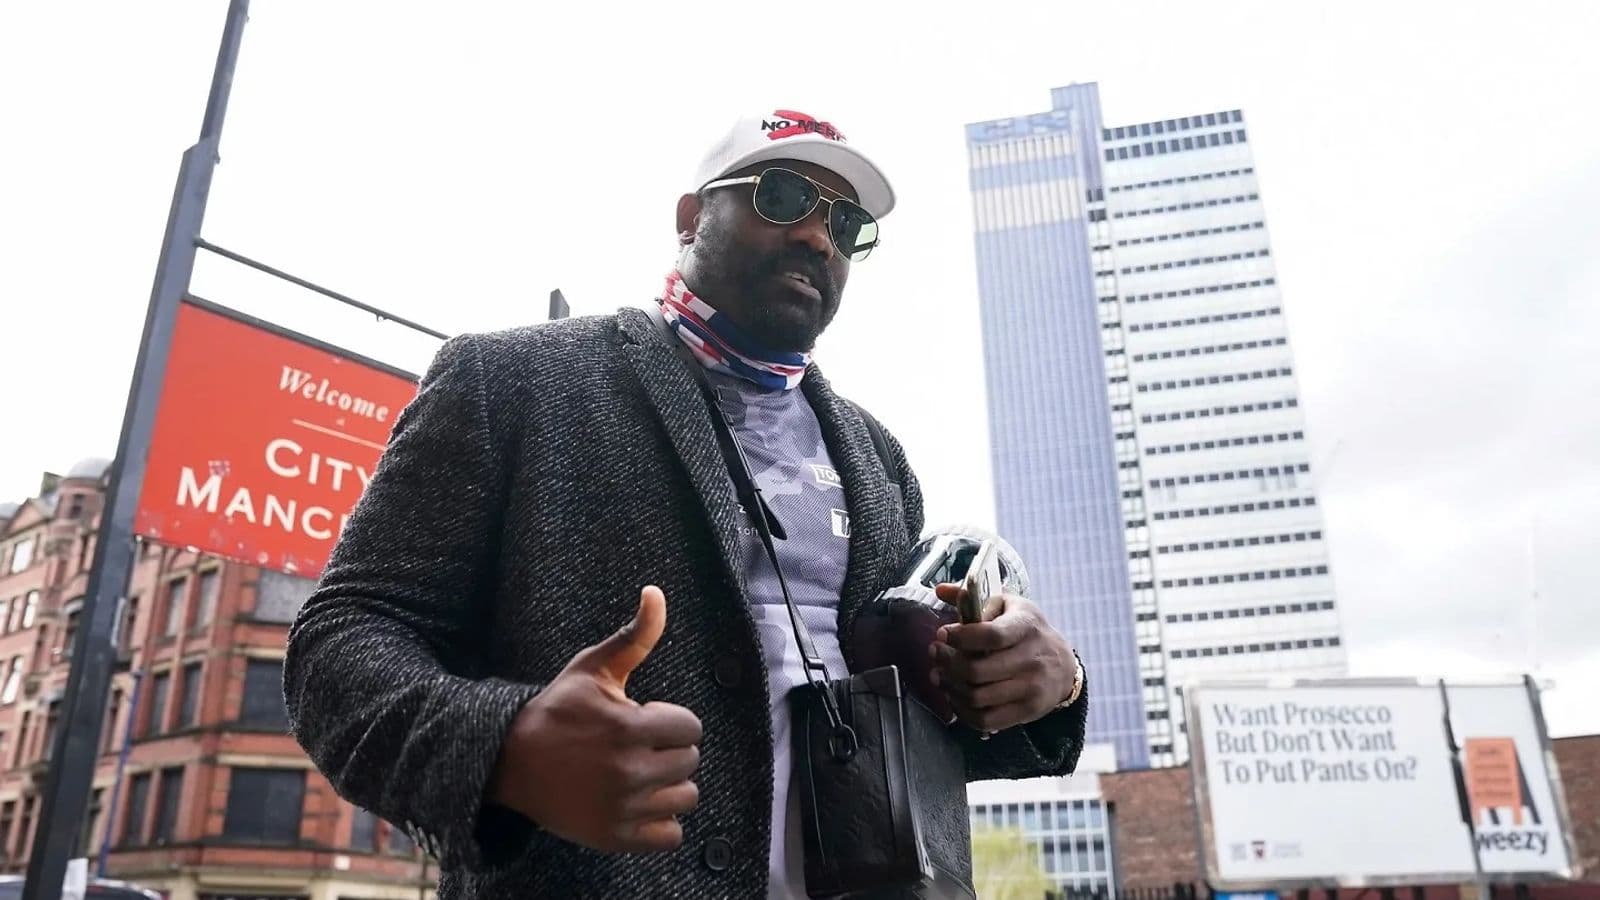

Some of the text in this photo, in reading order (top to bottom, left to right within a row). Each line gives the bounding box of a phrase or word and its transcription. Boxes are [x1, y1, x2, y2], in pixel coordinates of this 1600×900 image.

[760, 119, 790, 132] NO
[278, 364, 390, 423] Welcome
[1213, 702, 1391, 726] Want Prosecco
[1216, 728, 1396, 754] But Don't Want
[1216, 755, 1417, 784] To Put Pants On?
